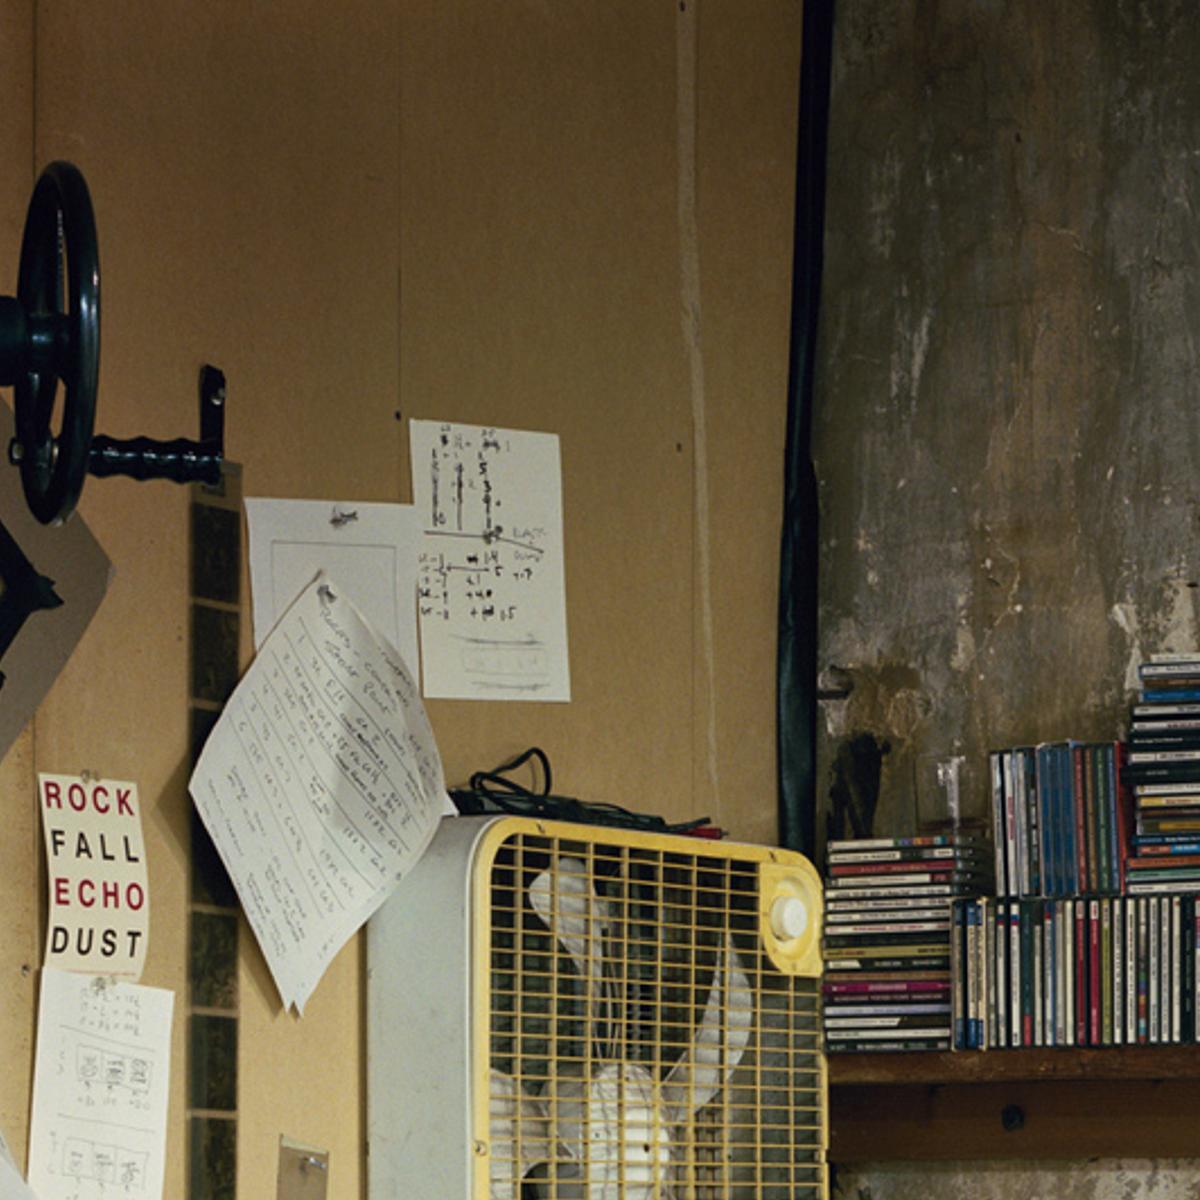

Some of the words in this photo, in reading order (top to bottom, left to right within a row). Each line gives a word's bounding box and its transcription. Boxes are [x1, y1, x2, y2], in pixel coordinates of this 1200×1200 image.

[44, 781, 134, 816] ROCK
[51, 829, 139, 863] FALL
[54, 877, 144, 910] ECHO
[51, 926, 141, 957] DUST
